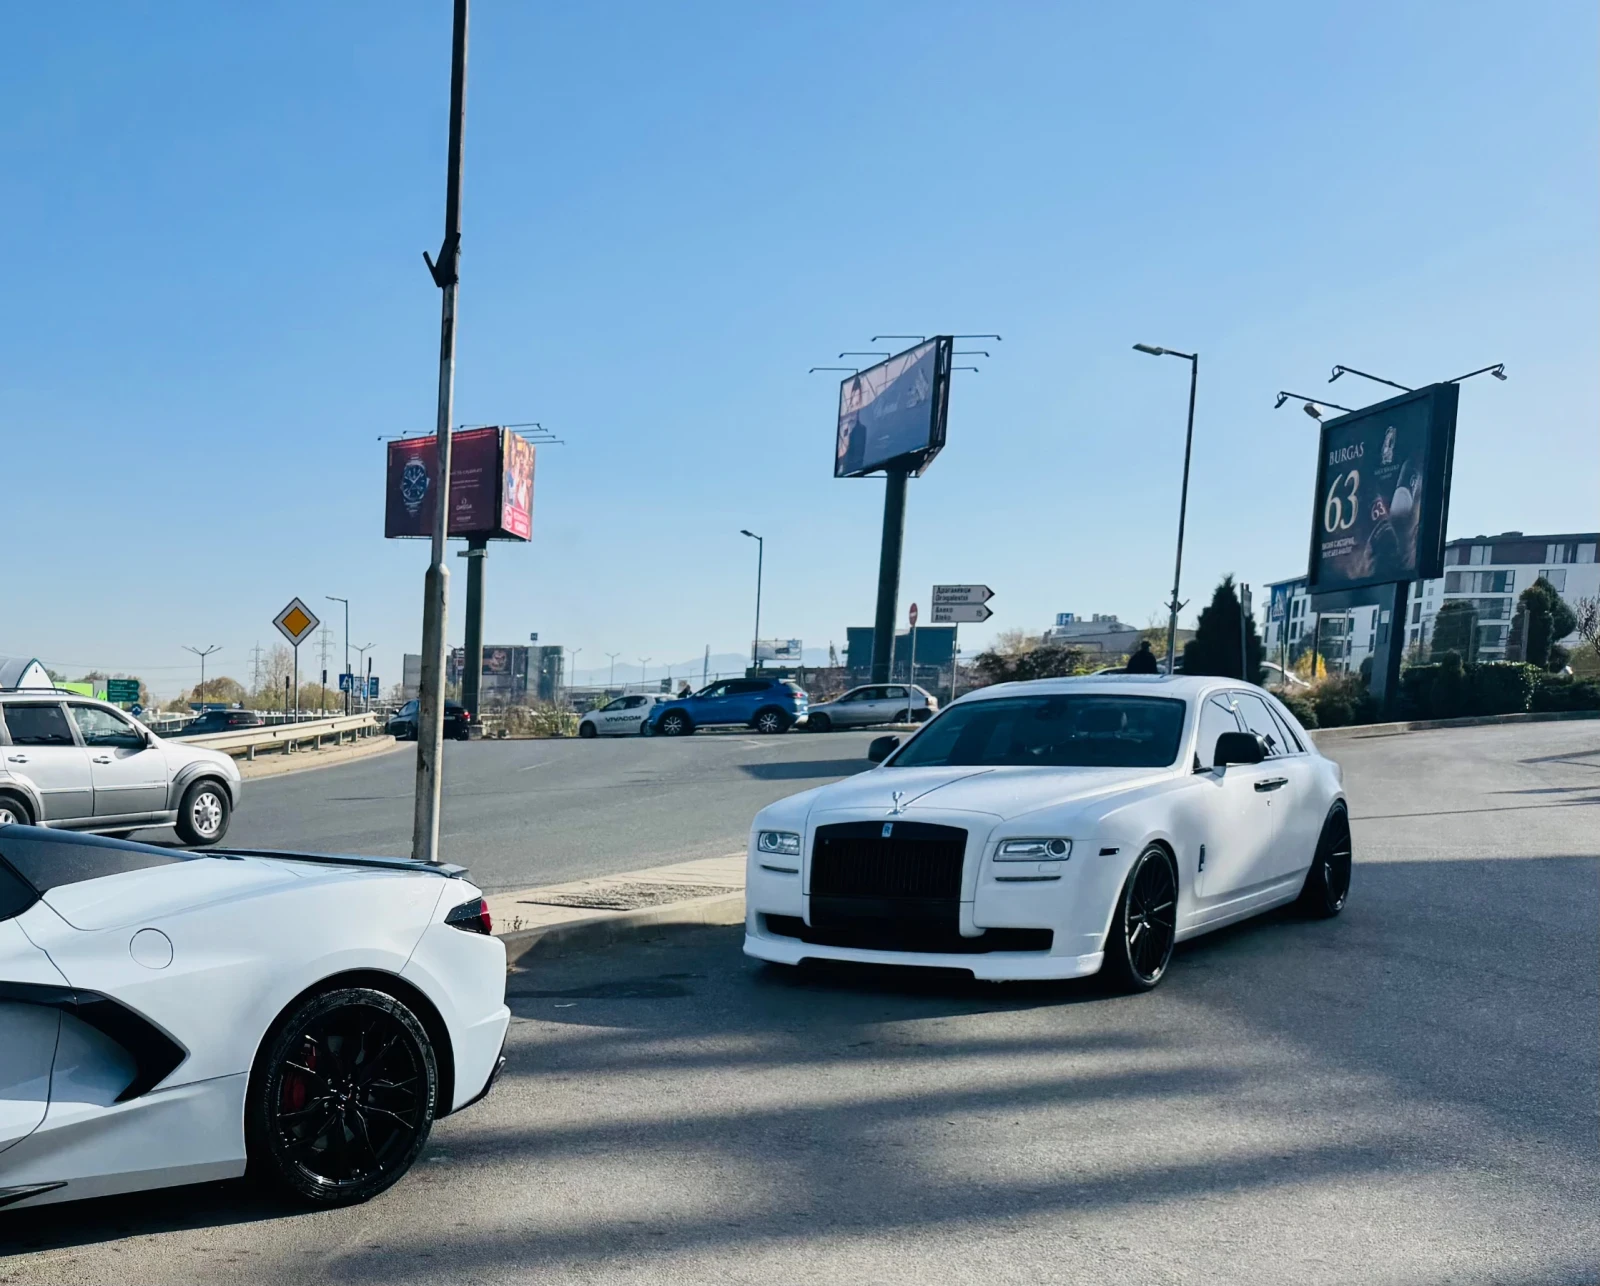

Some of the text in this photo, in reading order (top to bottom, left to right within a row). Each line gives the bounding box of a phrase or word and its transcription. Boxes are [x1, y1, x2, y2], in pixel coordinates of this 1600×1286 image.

[1329, 442, 1364, 465] BURGAS
[1324, 470, 1360, 533] 63
[1372, 501, 1386, 520] 63
